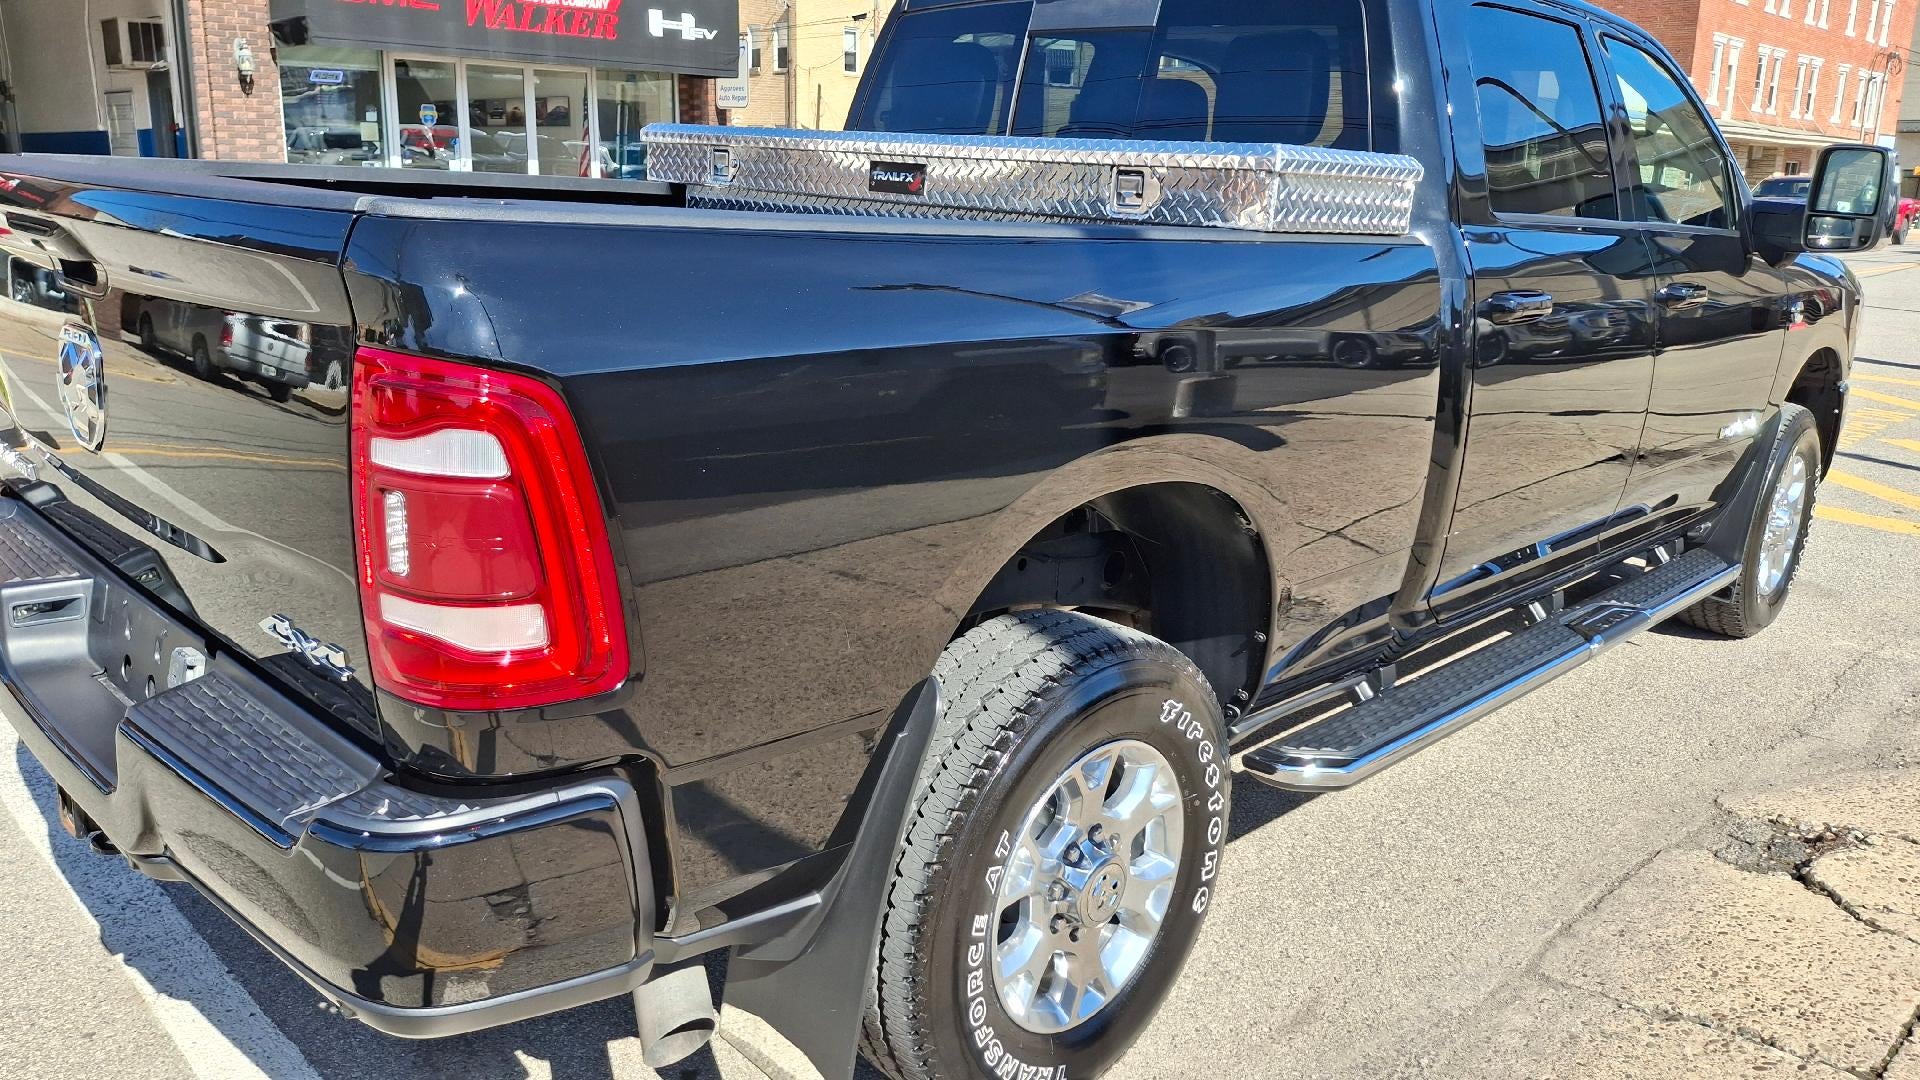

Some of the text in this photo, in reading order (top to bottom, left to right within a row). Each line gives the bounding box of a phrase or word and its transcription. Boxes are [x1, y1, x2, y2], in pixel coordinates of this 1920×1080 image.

[466, 0, 619, 41] WALKER
[872, 170, 914, 182] TRAILFX
[985, 830, 1011, 894] AT
